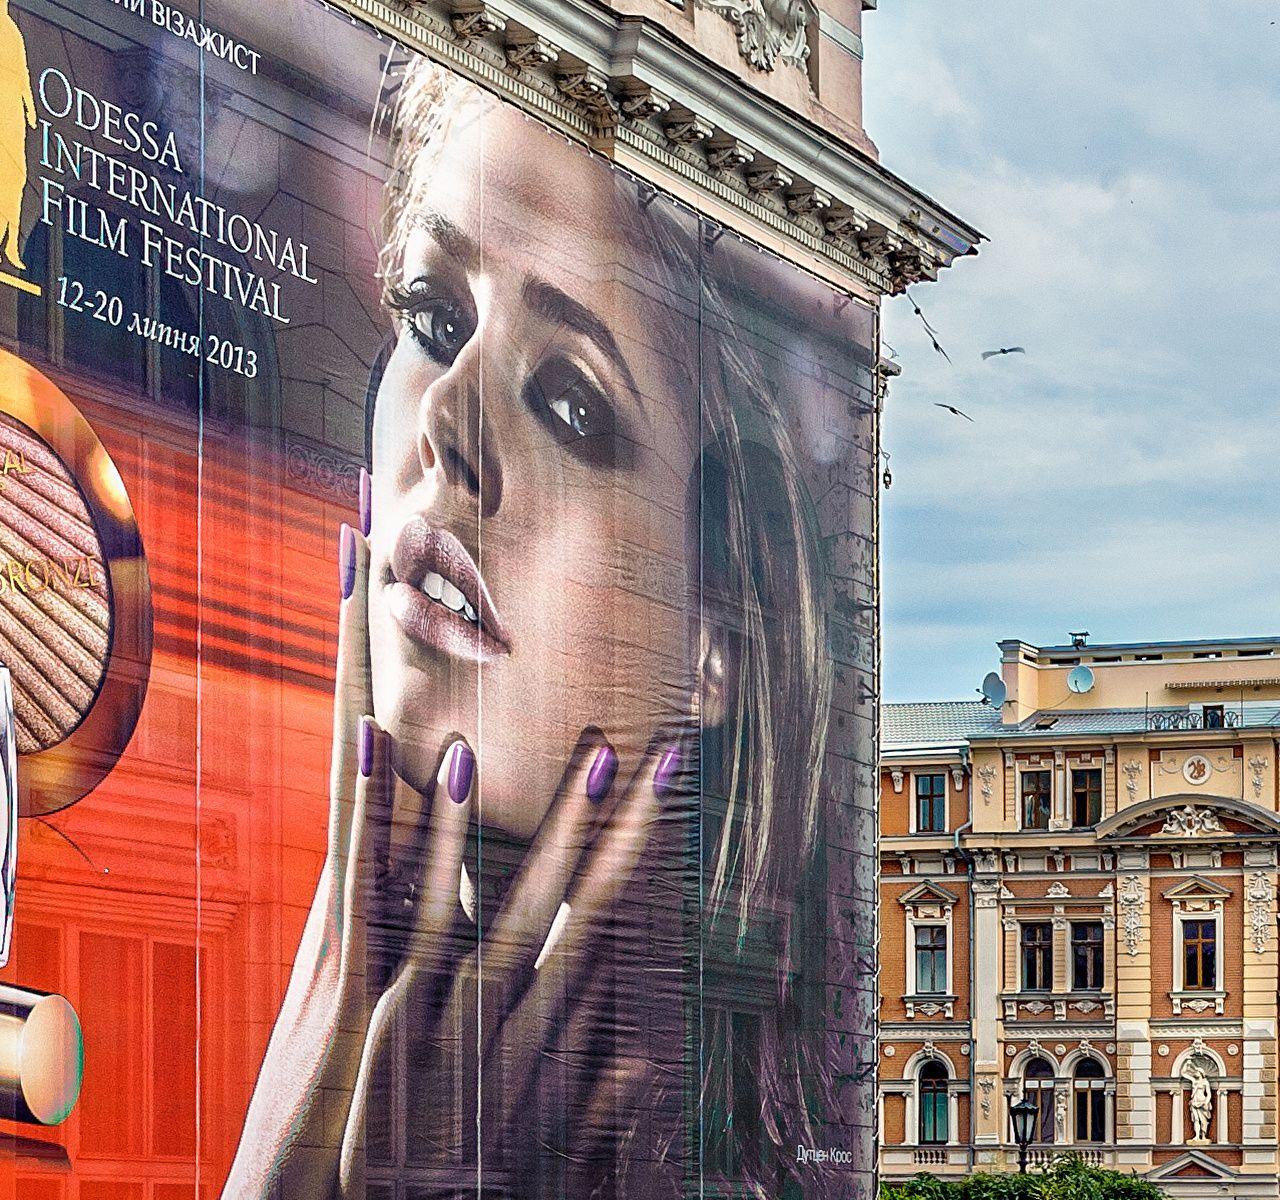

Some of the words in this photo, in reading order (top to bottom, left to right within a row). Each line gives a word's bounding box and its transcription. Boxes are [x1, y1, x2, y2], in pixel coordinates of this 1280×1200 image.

[152, 0, 262, 75] ВІЗАЖИСТ
[39, 67, 183, 173] ODESSA
[39, 118, 318, 285] INTERNATIONAL
[39, 175, 129, 259] FILM
[140, 219, 291, 324] FESTIVAL
[56, 276, 123, 326] 12-20
[127, 312, 200, 358] липня
[206, 334, 258, 379] 2013
